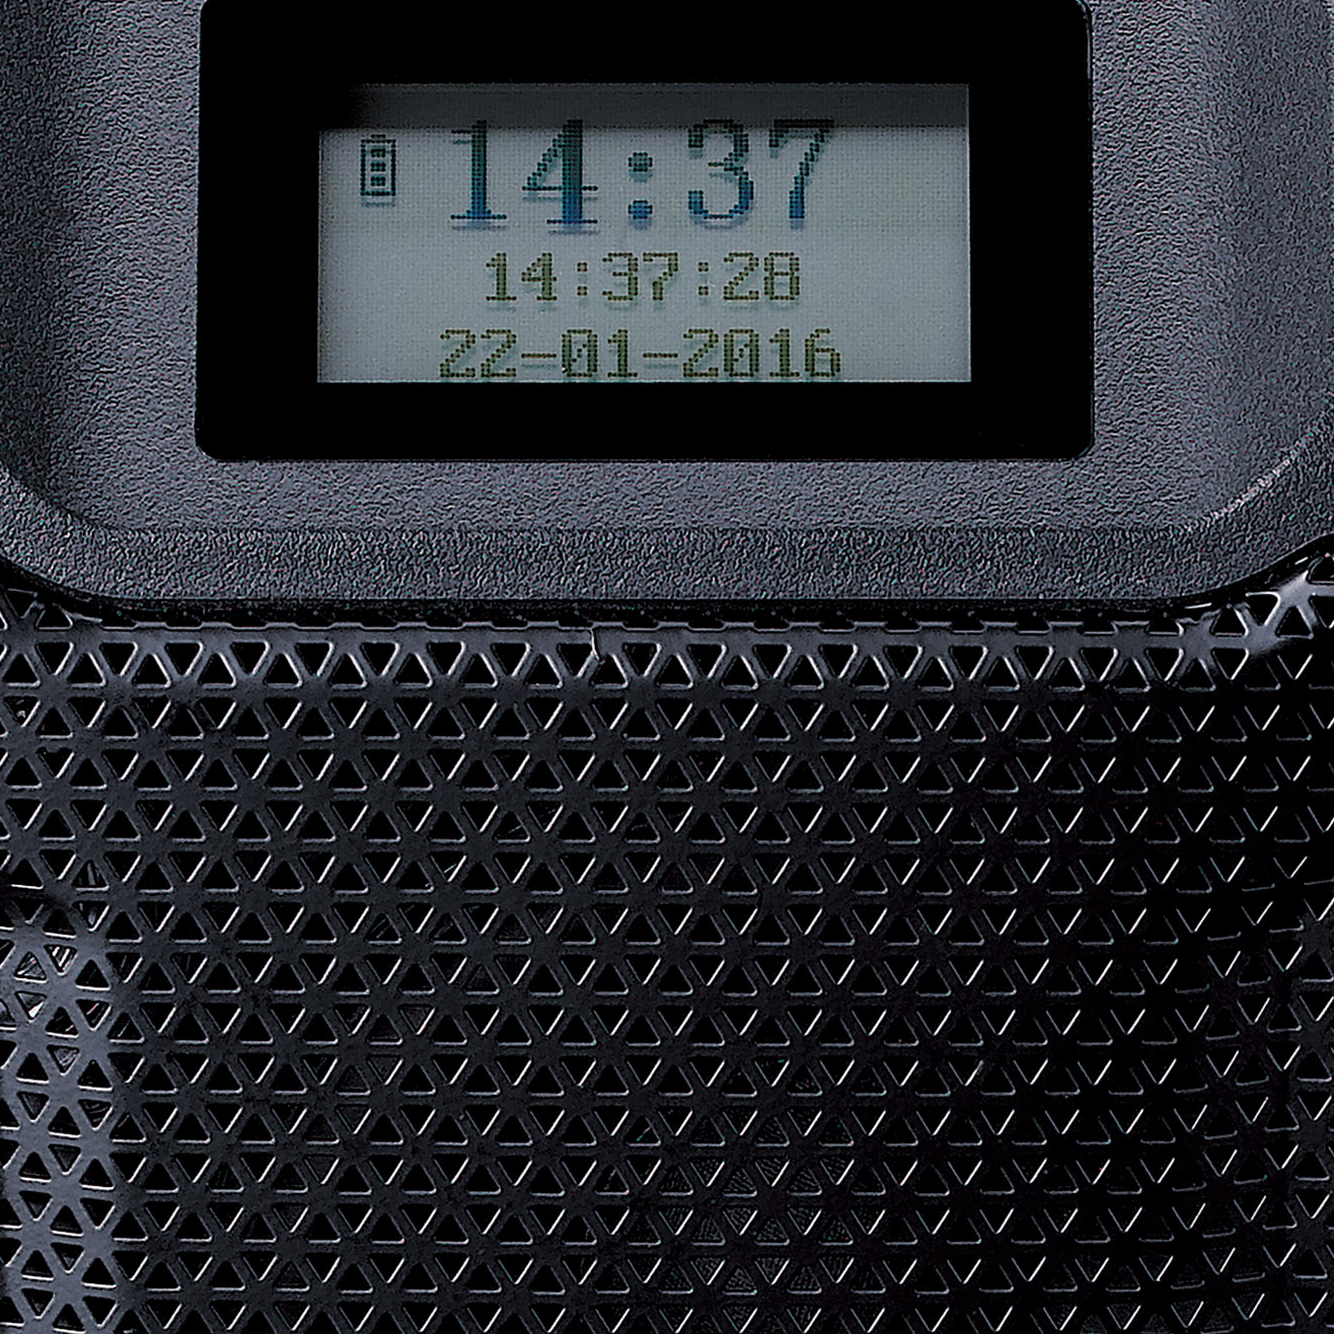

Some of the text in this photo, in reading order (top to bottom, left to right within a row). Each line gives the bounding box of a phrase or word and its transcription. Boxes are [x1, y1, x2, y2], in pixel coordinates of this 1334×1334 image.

[450, 119, 835, 224] 14:37
[486, 252, 801, 301] 14:37:28
[439, 329, 841, 378] 22-01-2016
